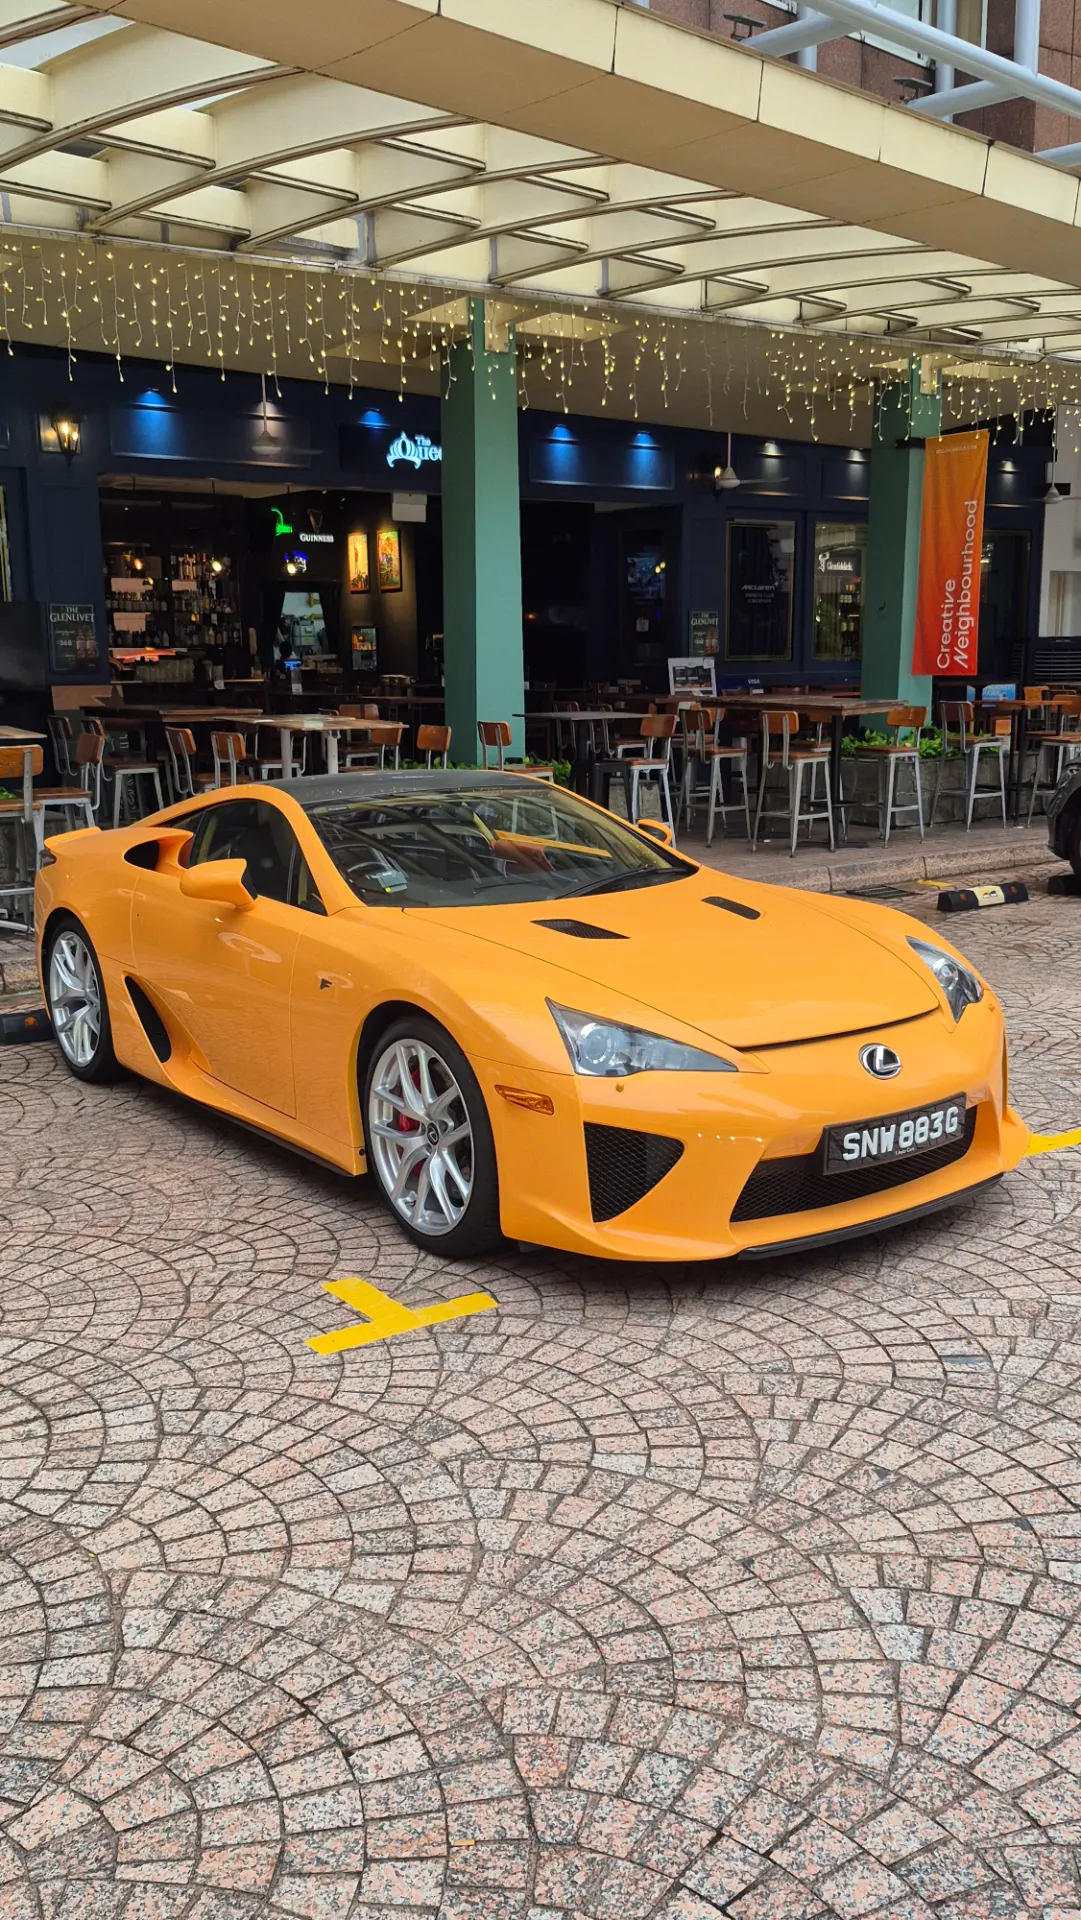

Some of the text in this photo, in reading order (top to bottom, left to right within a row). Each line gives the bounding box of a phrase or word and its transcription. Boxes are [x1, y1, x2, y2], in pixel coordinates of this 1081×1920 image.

[299, 533, 335, 543] GUINNESS
[953, 500, 978, 669] Neighbourhood
[49, 613, 95, 622] GLENLIVET
[691, 618, 719, 626] GLENLIVET
[936, 579, 956, 669] Creative
[842, 1106, 959, 1161] SNW 883G
